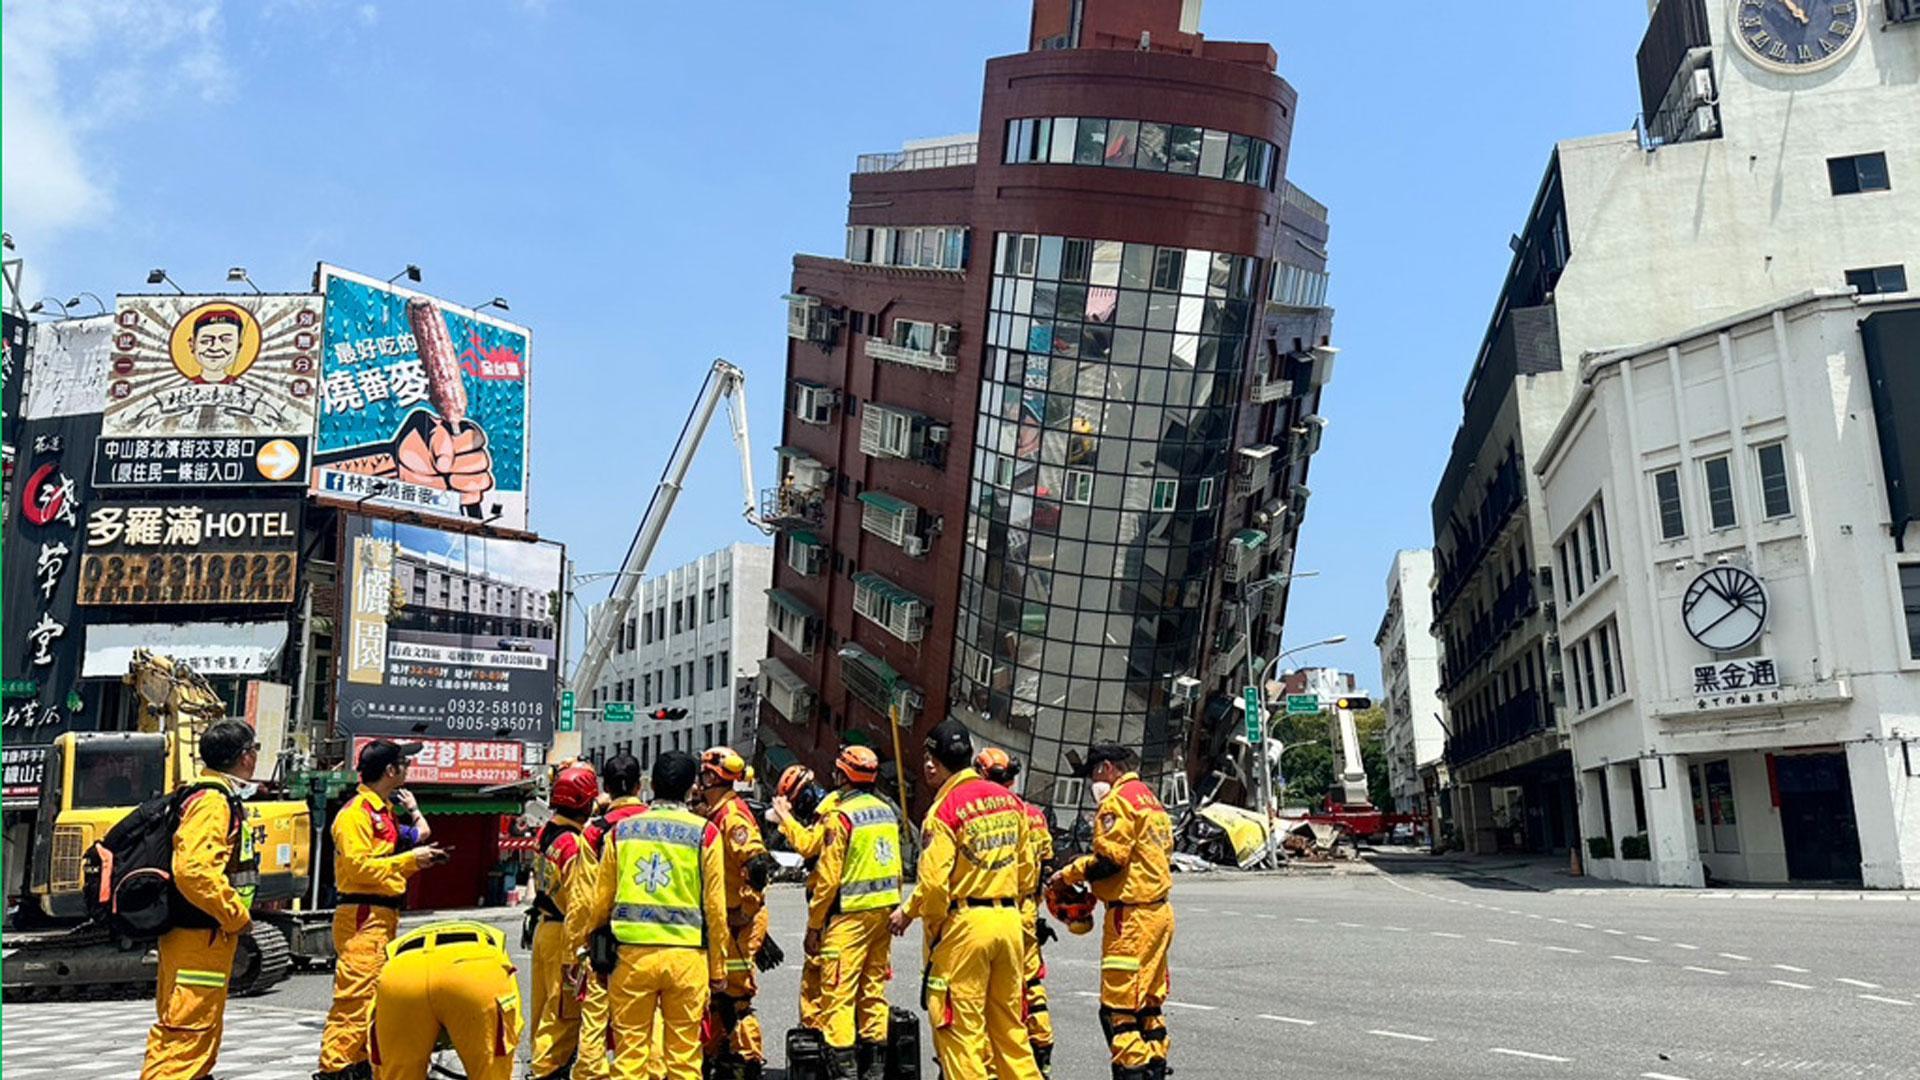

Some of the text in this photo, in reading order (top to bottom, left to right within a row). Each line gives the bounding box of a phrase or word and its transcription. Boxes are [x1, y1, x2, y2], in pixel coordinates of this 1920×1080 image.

[87, 505, 295, 546] 多羅滿 HOTEL
[1694, 659, 1777, 693] 黑金通
[447, 699, 543, 716] 0932-581018
